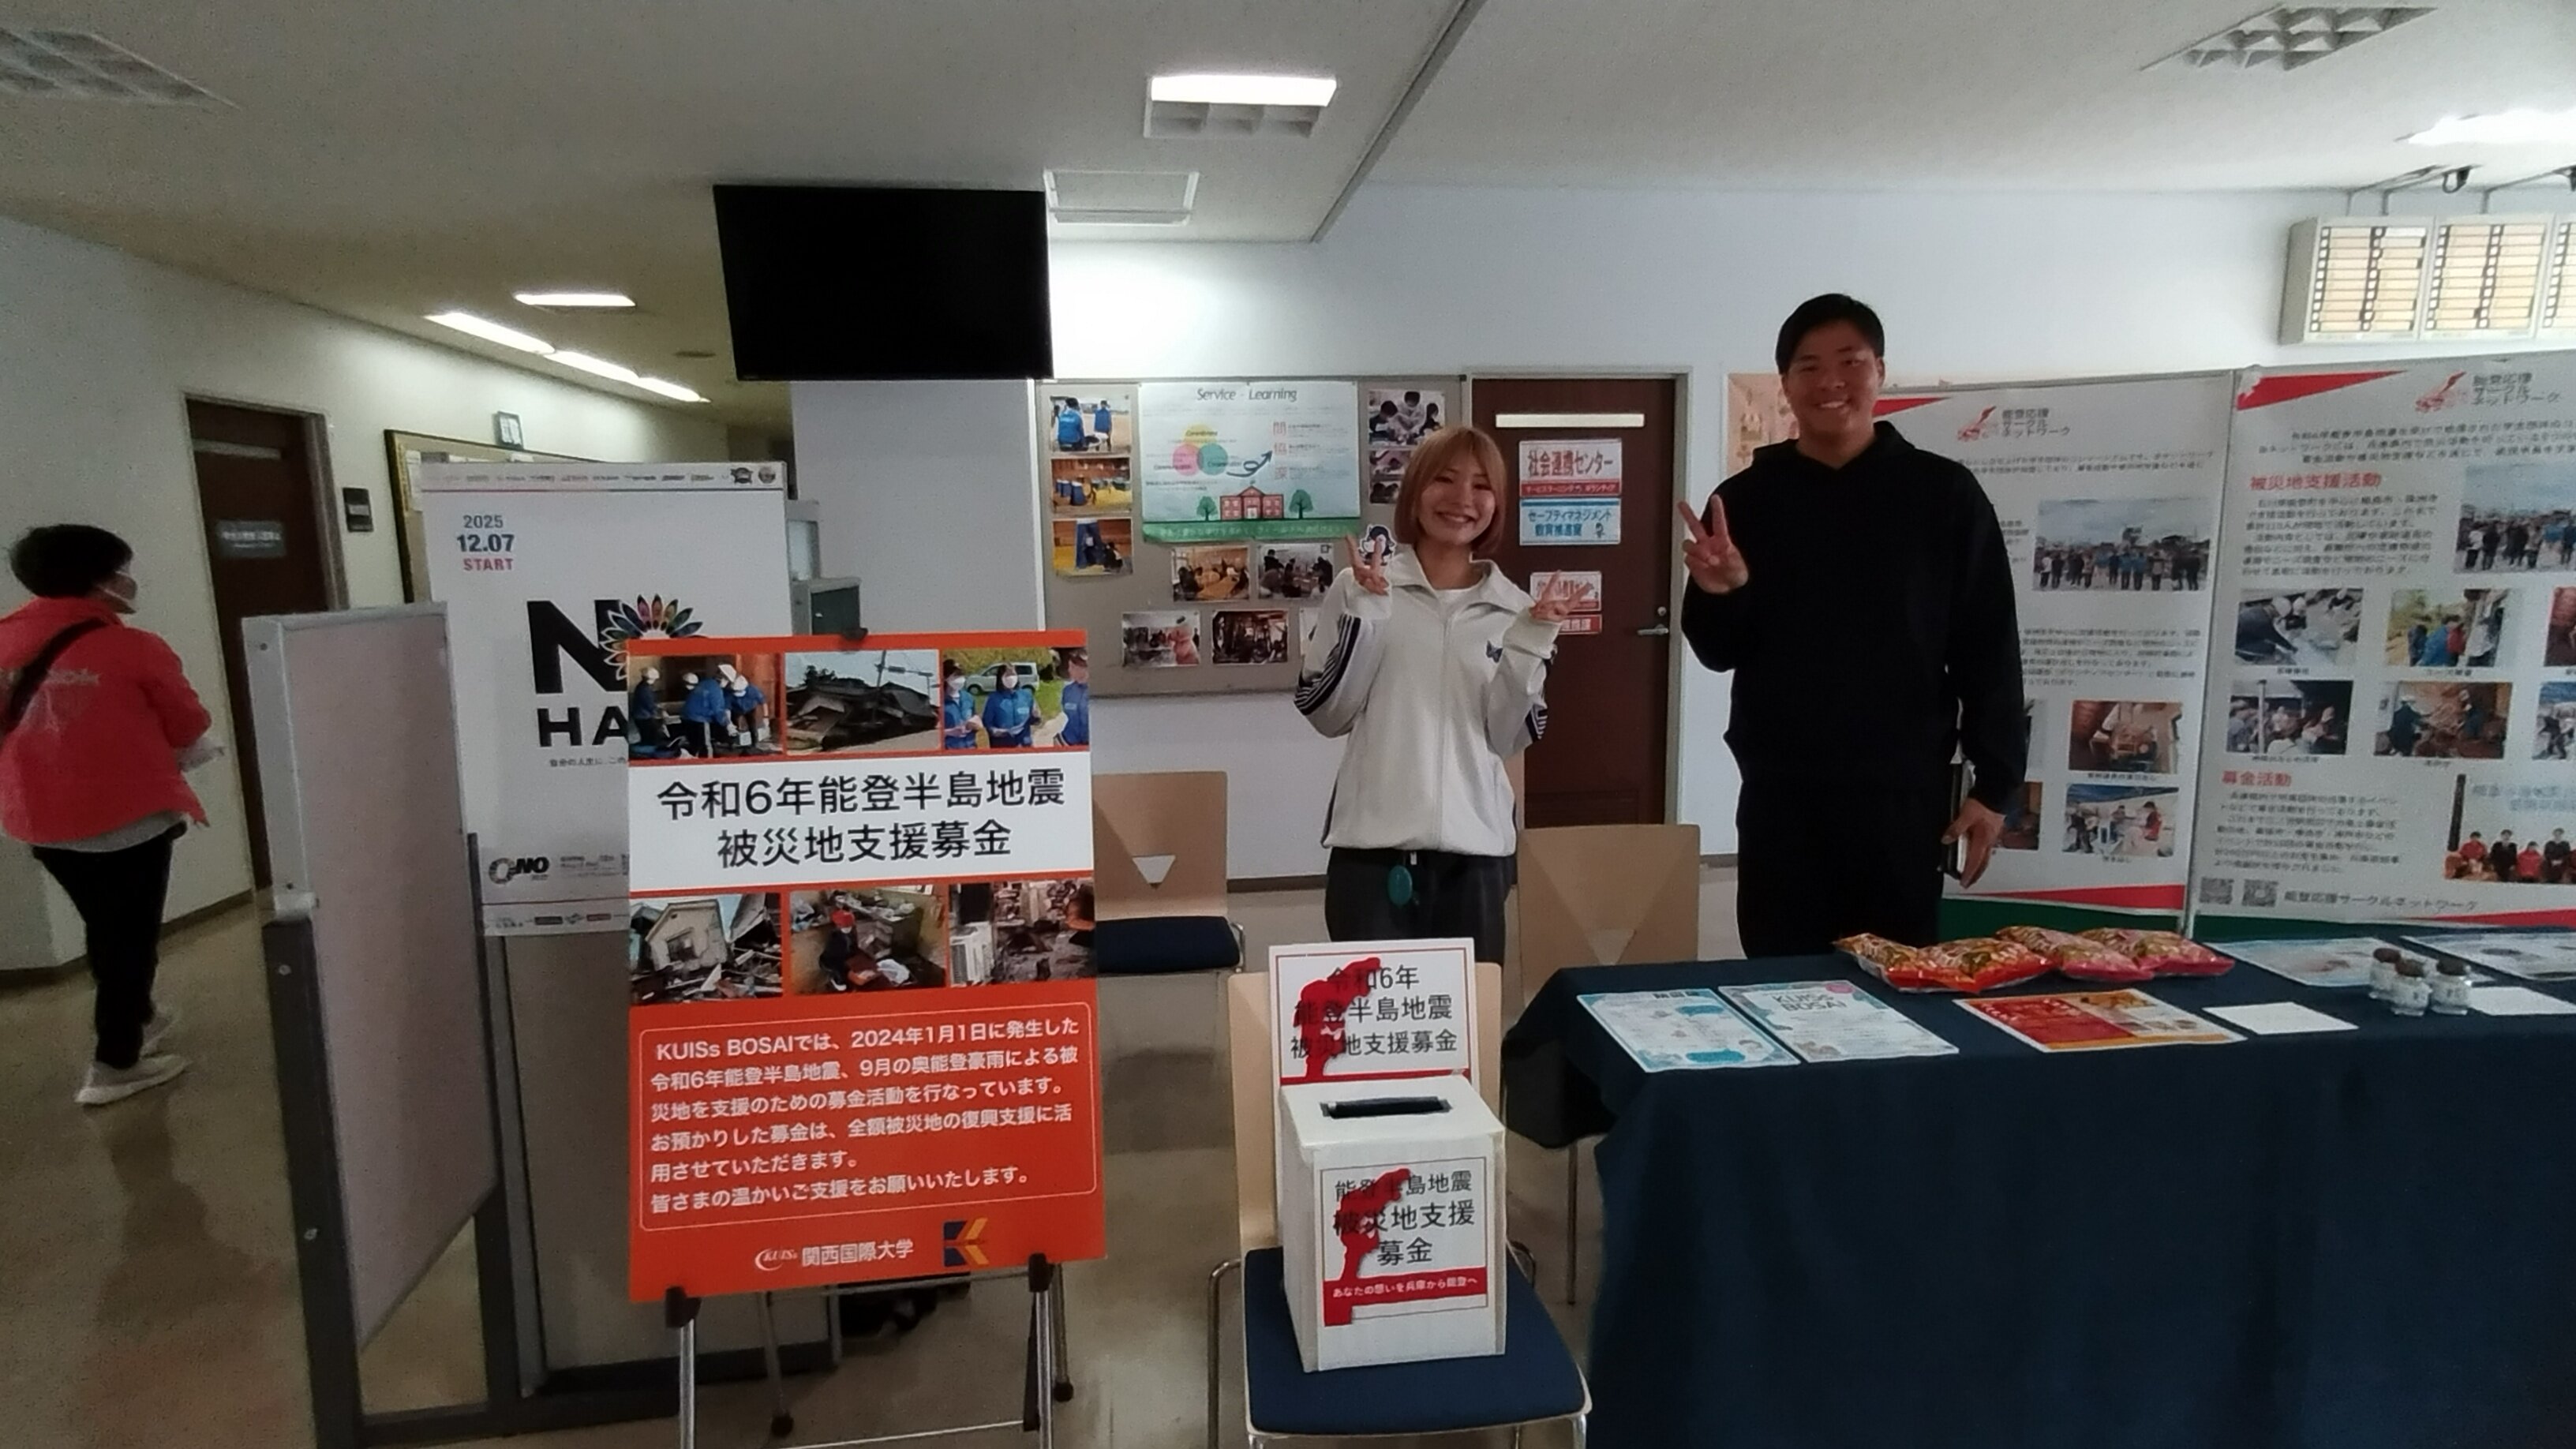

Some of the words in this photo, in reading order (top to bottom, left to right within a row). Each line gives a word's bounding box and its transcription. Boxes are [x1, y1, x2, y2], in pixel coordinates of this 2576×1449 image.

[1196, 388, 1237, 401] Service
[1249, 388, 1297, 402] Learning
[2249, 472, 2383, 490] 被災地支援活動
[462, 515, 504, 530] 2025
[456, 534, 515, 553] 12.07
[462, 557, 514, 571] START
[657, 768, 1065, 822] 令和6年能登半島地震
[717, 818, 1012, 869] 被災地支援募金
[1781, 1001, 1848, 1012] BOSAI
[657, 1042, 721, 1061] KUISs
[728, 1017, 1079, 1057] BOSAIでは、2024年1月1日に発生した
[1290, 1028, 1458, 1059] 被地支援募金
[651, 1046, 1078, 1091] 令和6年能登半島地震、9月の奥能登豪雨による被
[651, 1076, 1062, 1122] 災地を支援のための募金活動を行なっています。
[651, 1104, 1073, 1152] お預かりした募金は、全額被災地の復興支援に活
[651, 1151, 857, 1182] 用させていただきます。
[651, 1168, 1028, 1214] 皆さまの温かいご支援をお願いいたします。
[1335, 1170, 1472, 1202] 能島地震
[1333, 1199, 1475, 1236] 災地支援
[802, 1238, 914, 1267] 関西国際大学
[1377, 1237, 1432, 1267] 募金
